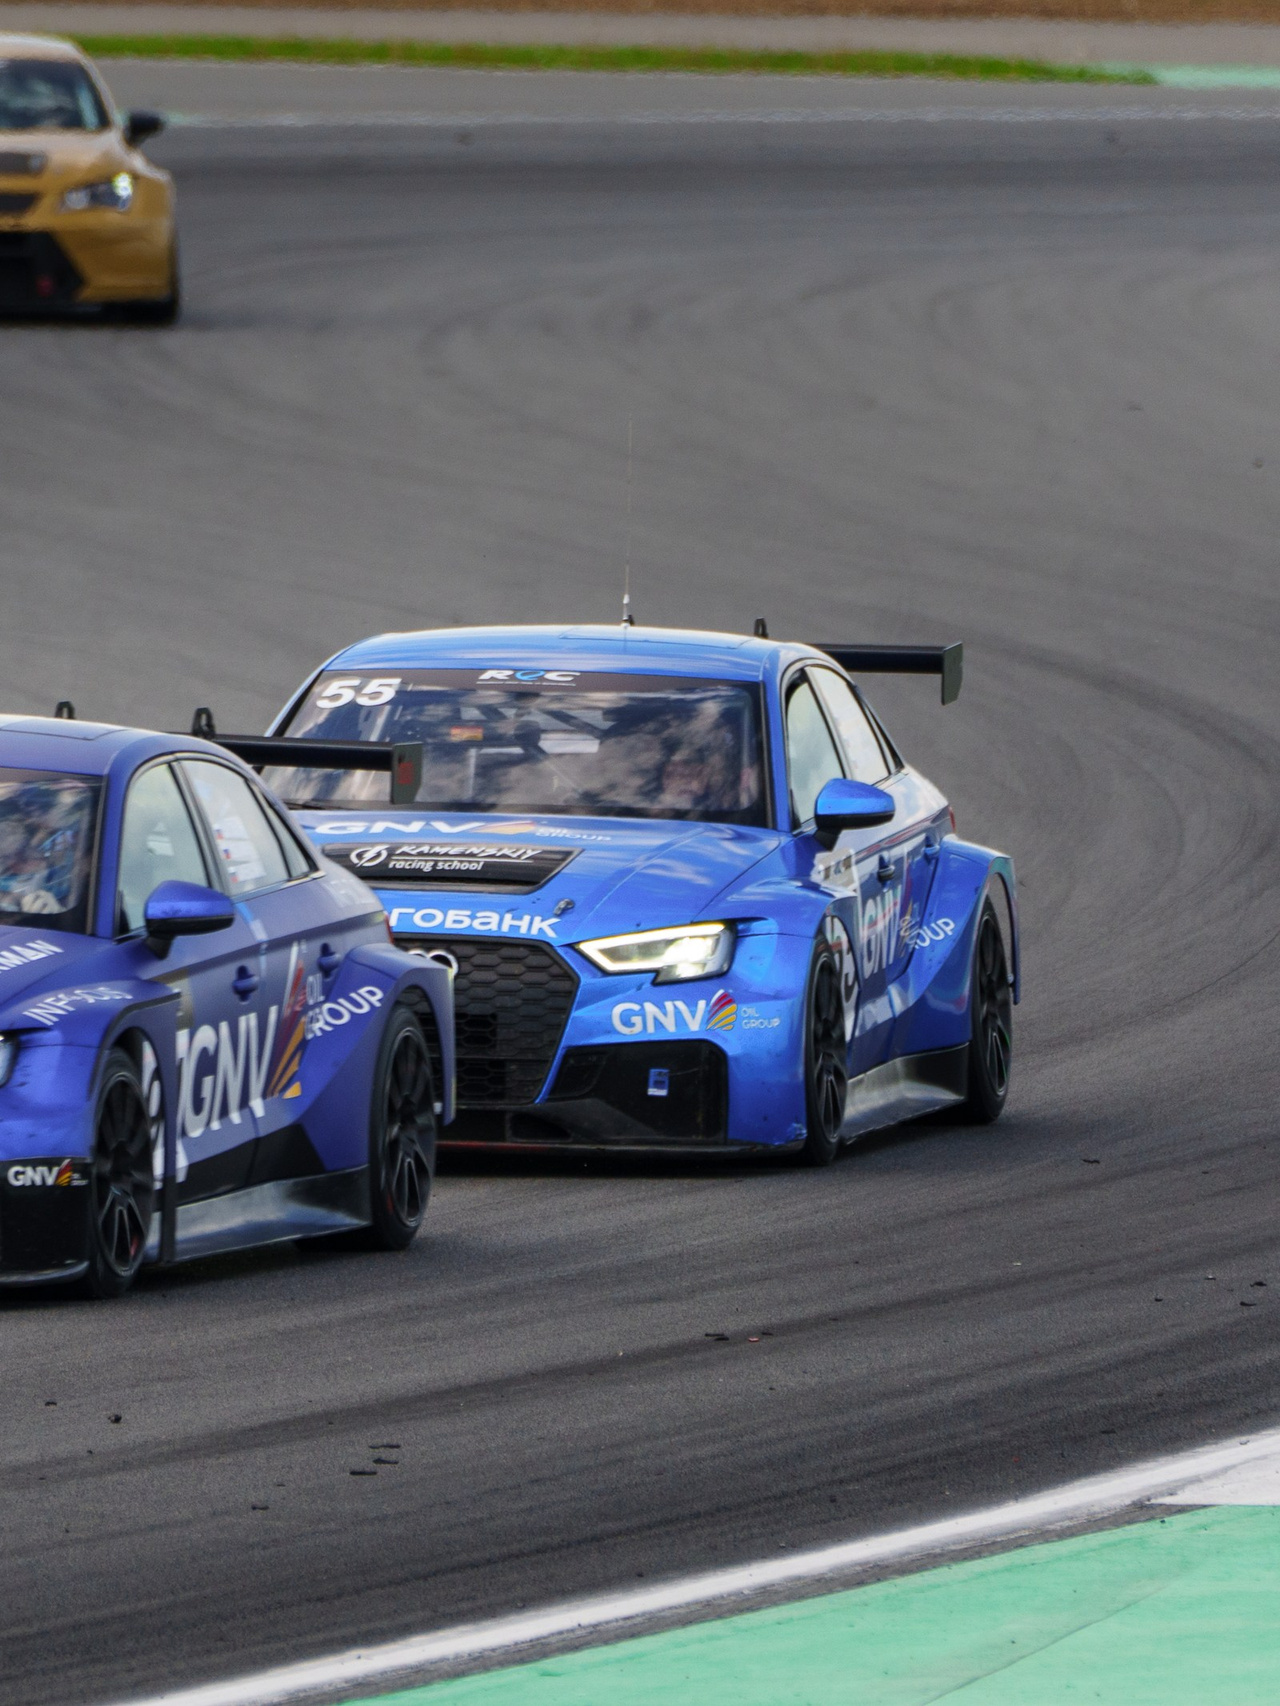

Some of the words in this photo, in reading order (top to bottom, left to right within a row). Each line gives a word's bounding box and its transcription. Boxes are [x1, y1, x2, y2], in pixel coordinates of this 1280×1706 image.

[316, 678, 402, 709] 55
[315, 821, 485, 834] GNV
[394, 844, 543, 861] KAMENSKIY
[388, 859, 433, 872] racing
[436, 860, 484, 871] school
[611, 999, 706, 1035] GNV
[742, 1018, 781, 1029] GROUP
[183, 1004, 280, 1139] GNV
[7, 1165, 60, 1187] GNV
